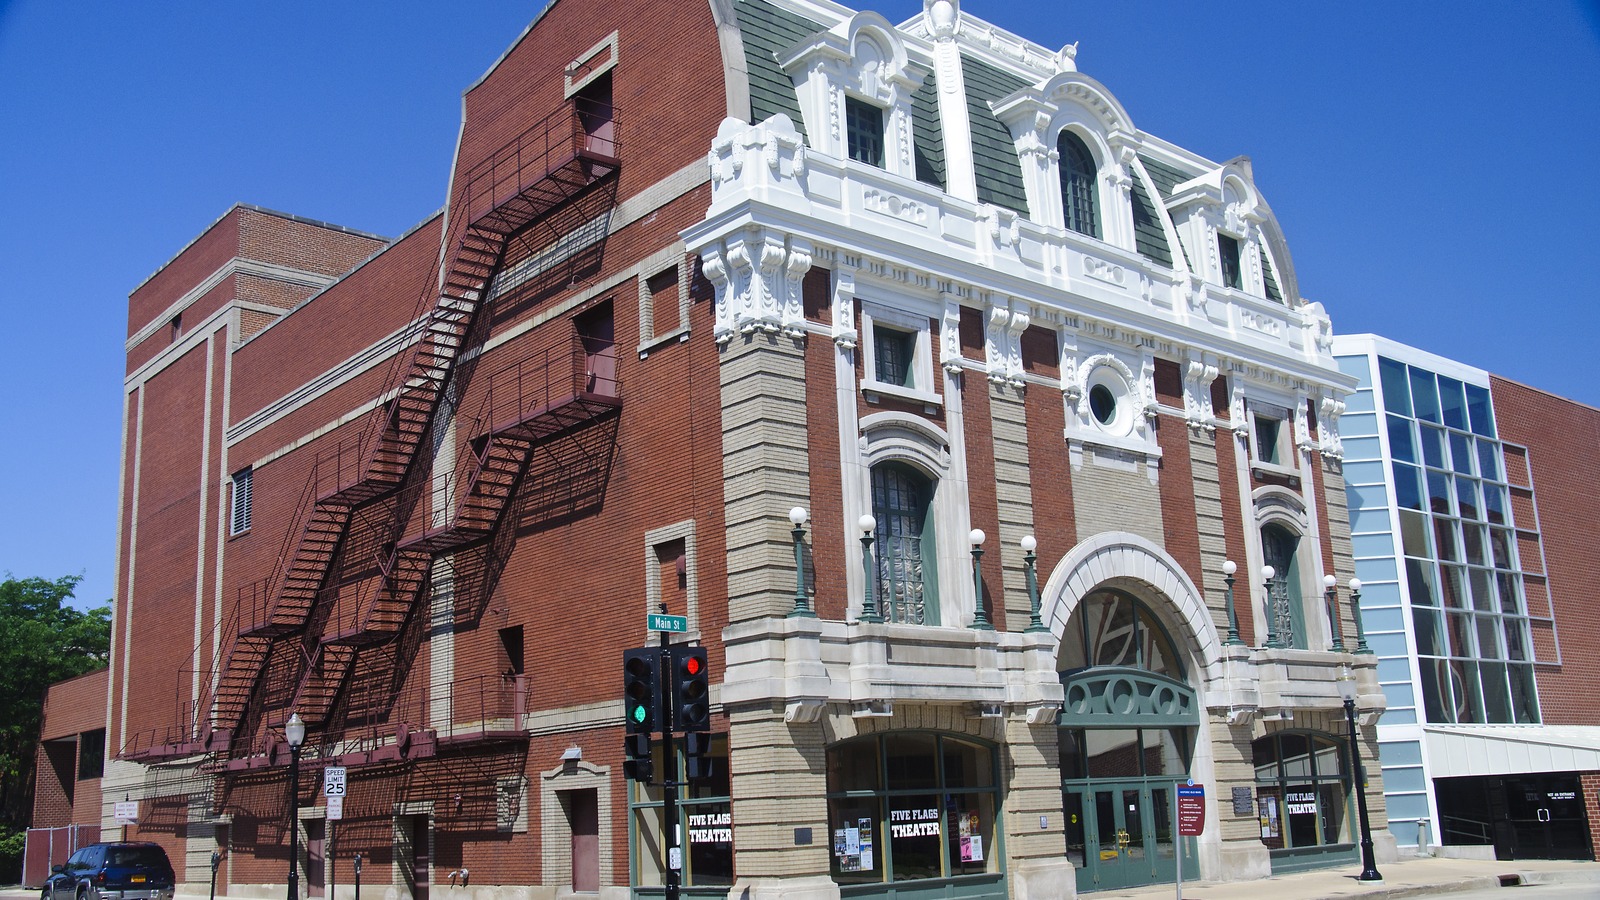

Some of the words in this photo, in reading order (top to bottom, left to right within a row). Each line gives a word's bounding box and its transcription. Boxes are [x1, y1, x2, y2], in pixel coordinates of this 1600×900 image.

[655, 617, 671, 629] Main
[673, 620, 680, 630] St
[326, 783, 344, 794] 25
[1286, 793, 1298, 802] FIVE
[1298, 792, 1315, 801] FLAGS
[890, 810, 911, 821] FIVE
[911, 808, 939, 820] FLAGS
[1287, 803, 1317, 815] THEATER
[689, 815, 706, 825] FIVE
[707, 813, 731, 825] FLAGS
[689, 829, 732, 842] THEATER
[891, 822, 940, 838] THEATER
